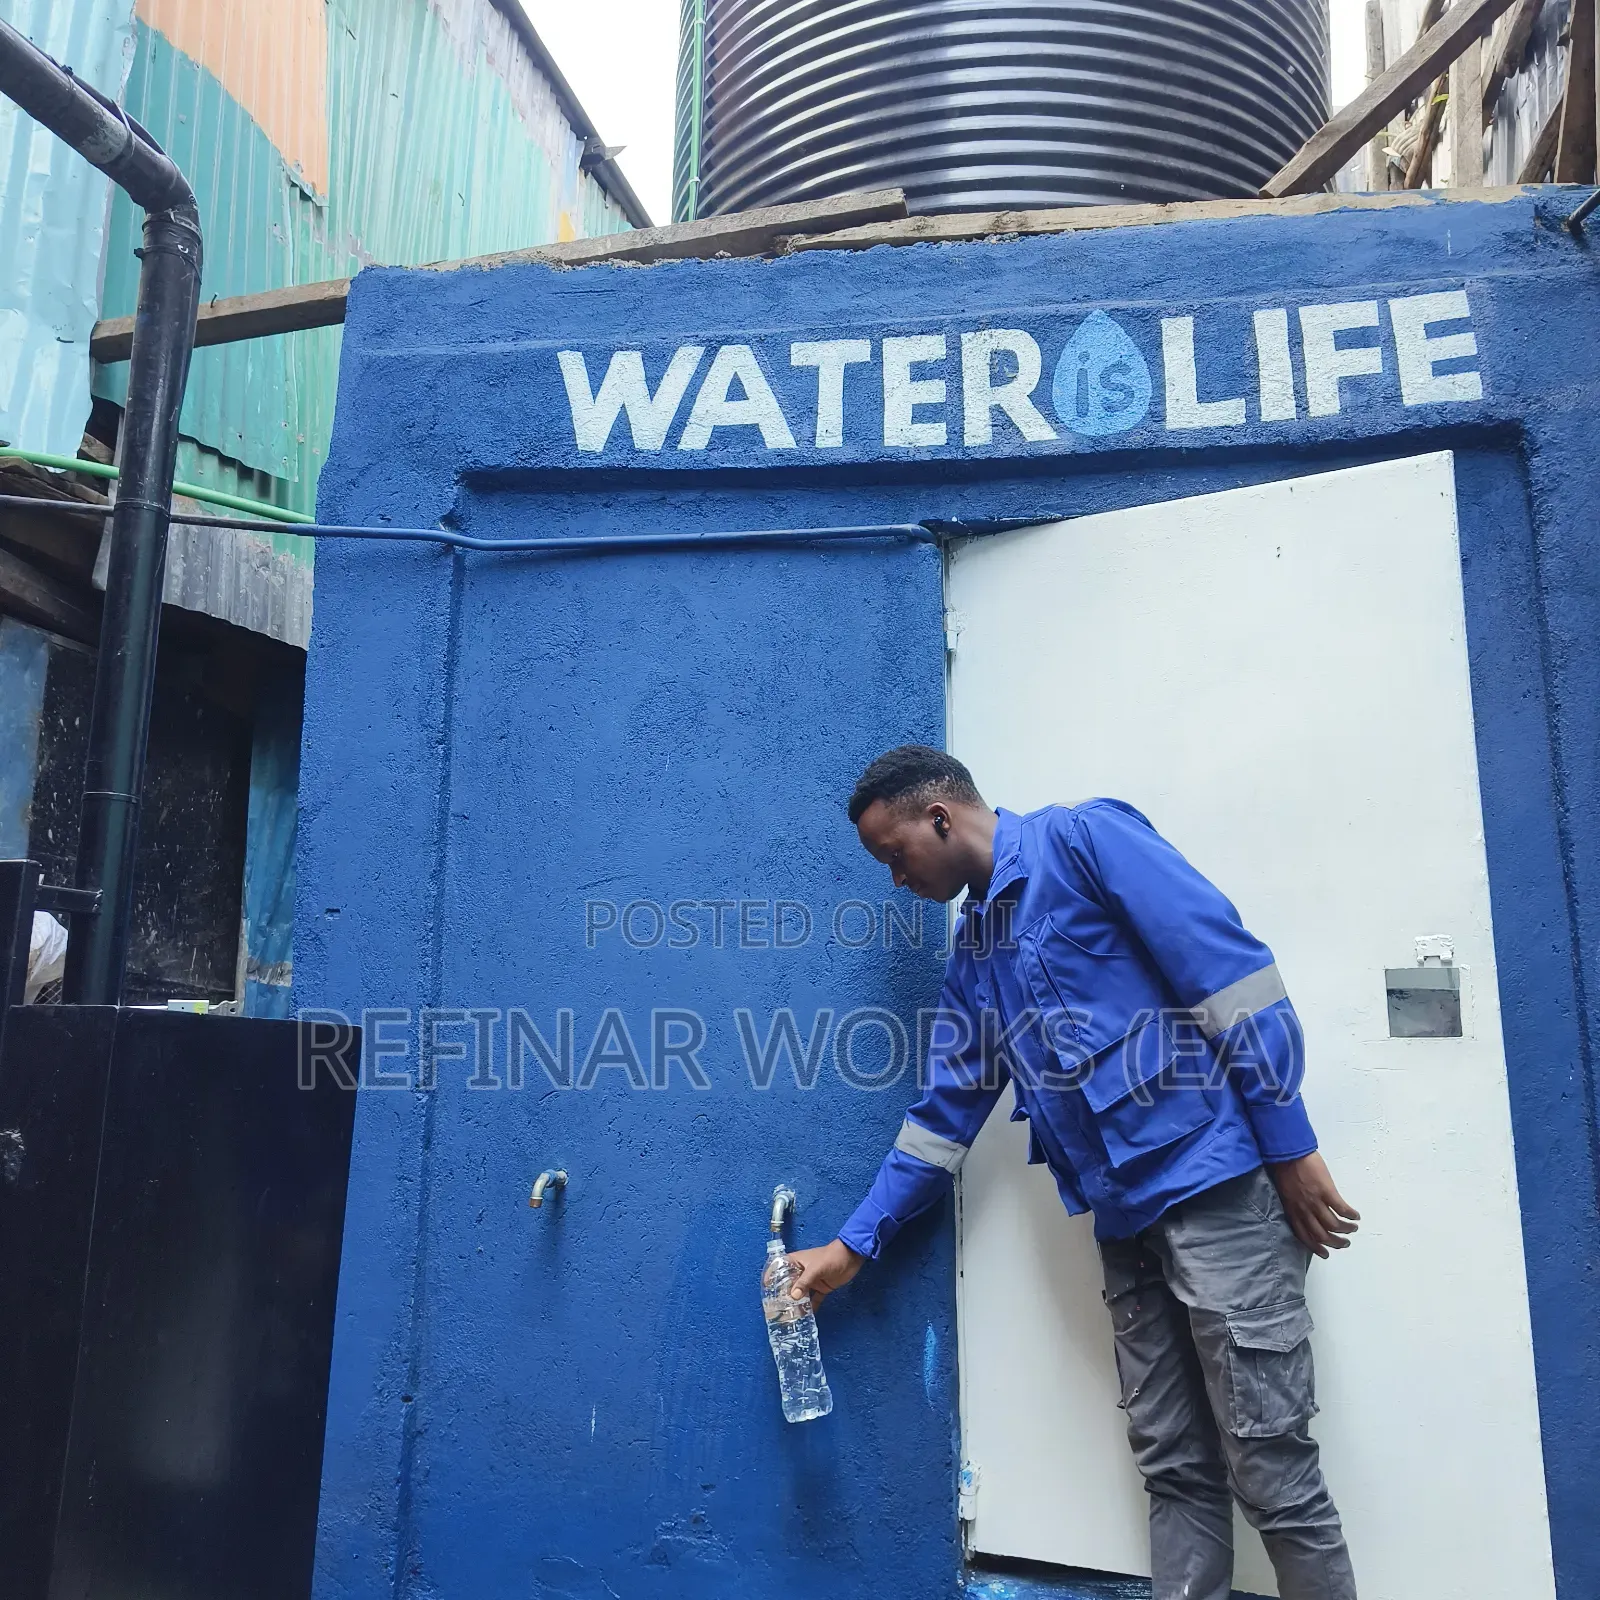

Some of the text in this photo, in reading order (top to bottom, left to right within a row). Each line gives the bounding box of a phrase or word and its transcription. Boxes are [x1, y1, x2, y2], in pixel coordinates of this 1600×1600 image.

[556, 290, 1484, 453] WATER is LIFE
